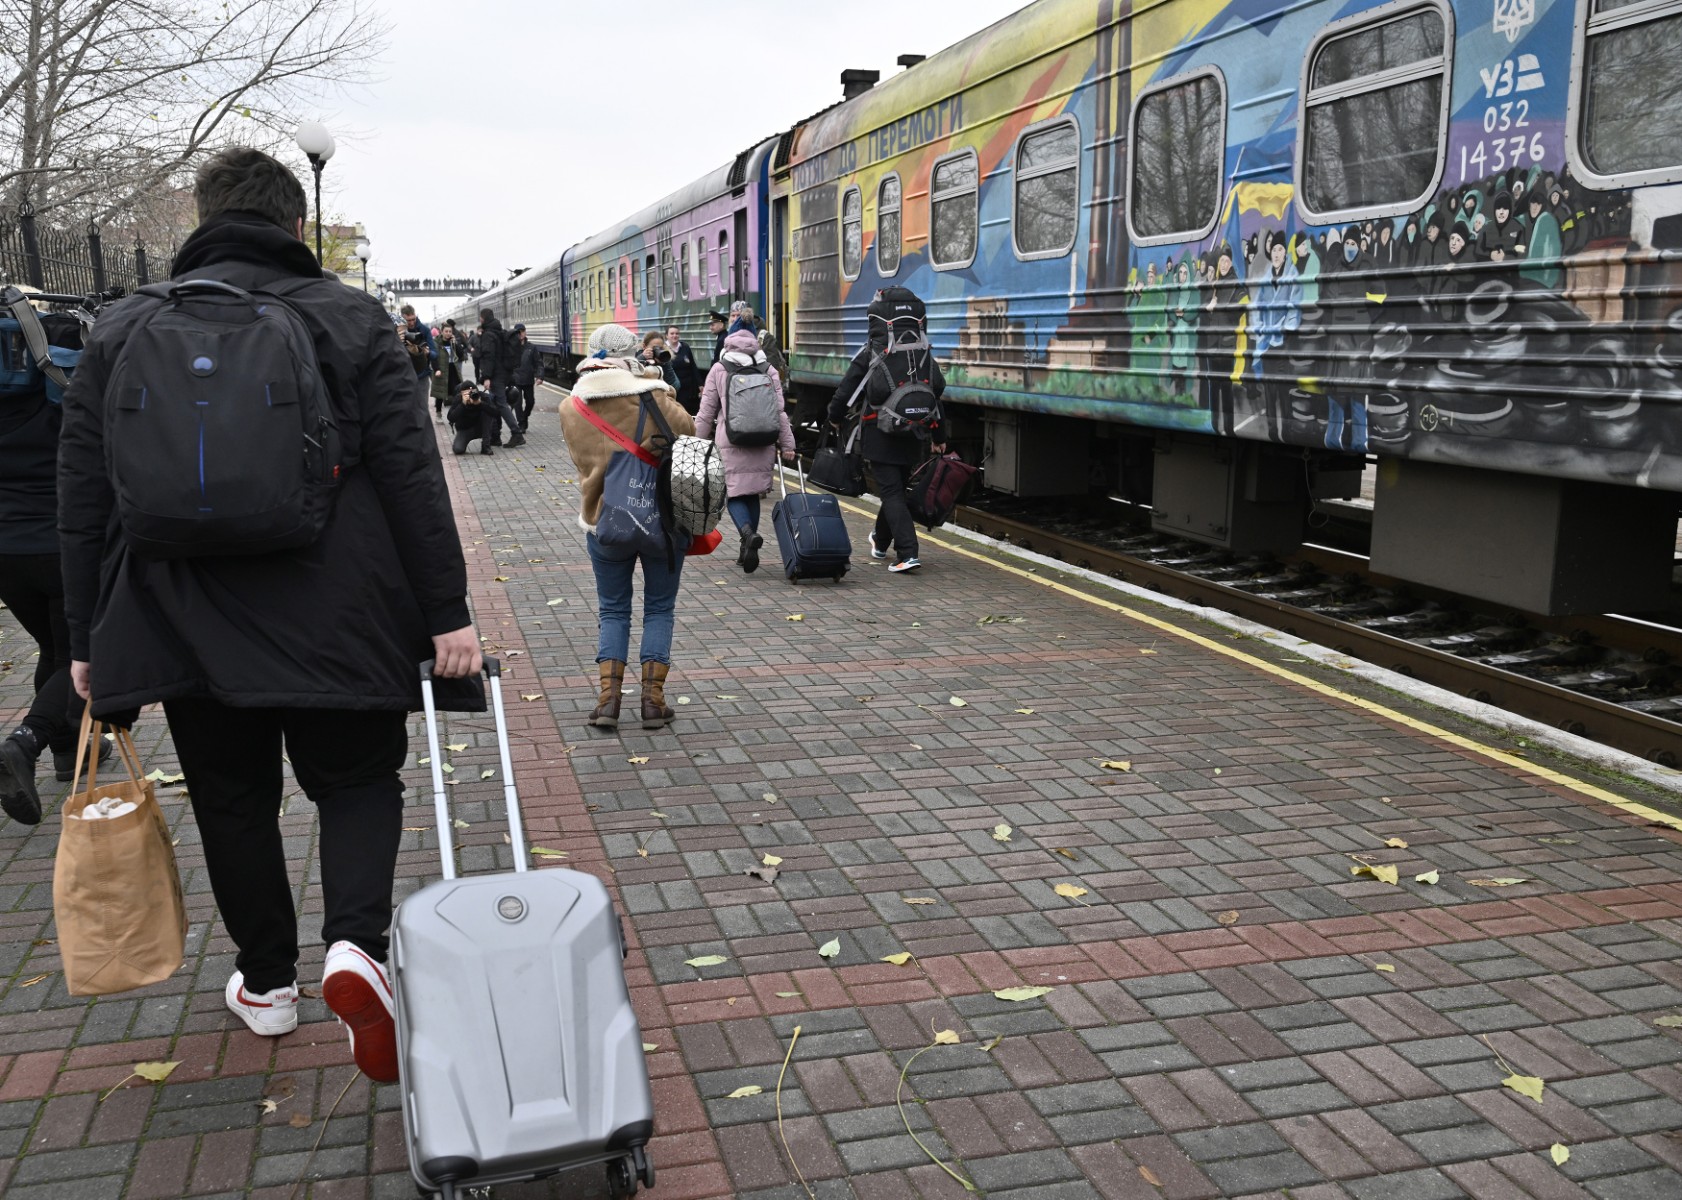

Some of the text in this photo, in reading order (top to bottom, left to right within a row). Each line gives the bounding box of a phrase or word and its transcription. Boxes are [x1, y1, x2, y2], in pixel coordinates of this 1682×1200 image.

[1483, 100, 1529, 133] 032
[793, 95, 963, 193] ПОТЯГ ДО ПЕРЕМОГИ
[1460, 132, 1545, 181] 14376
[275, 991, 291, 1001] NIKE
